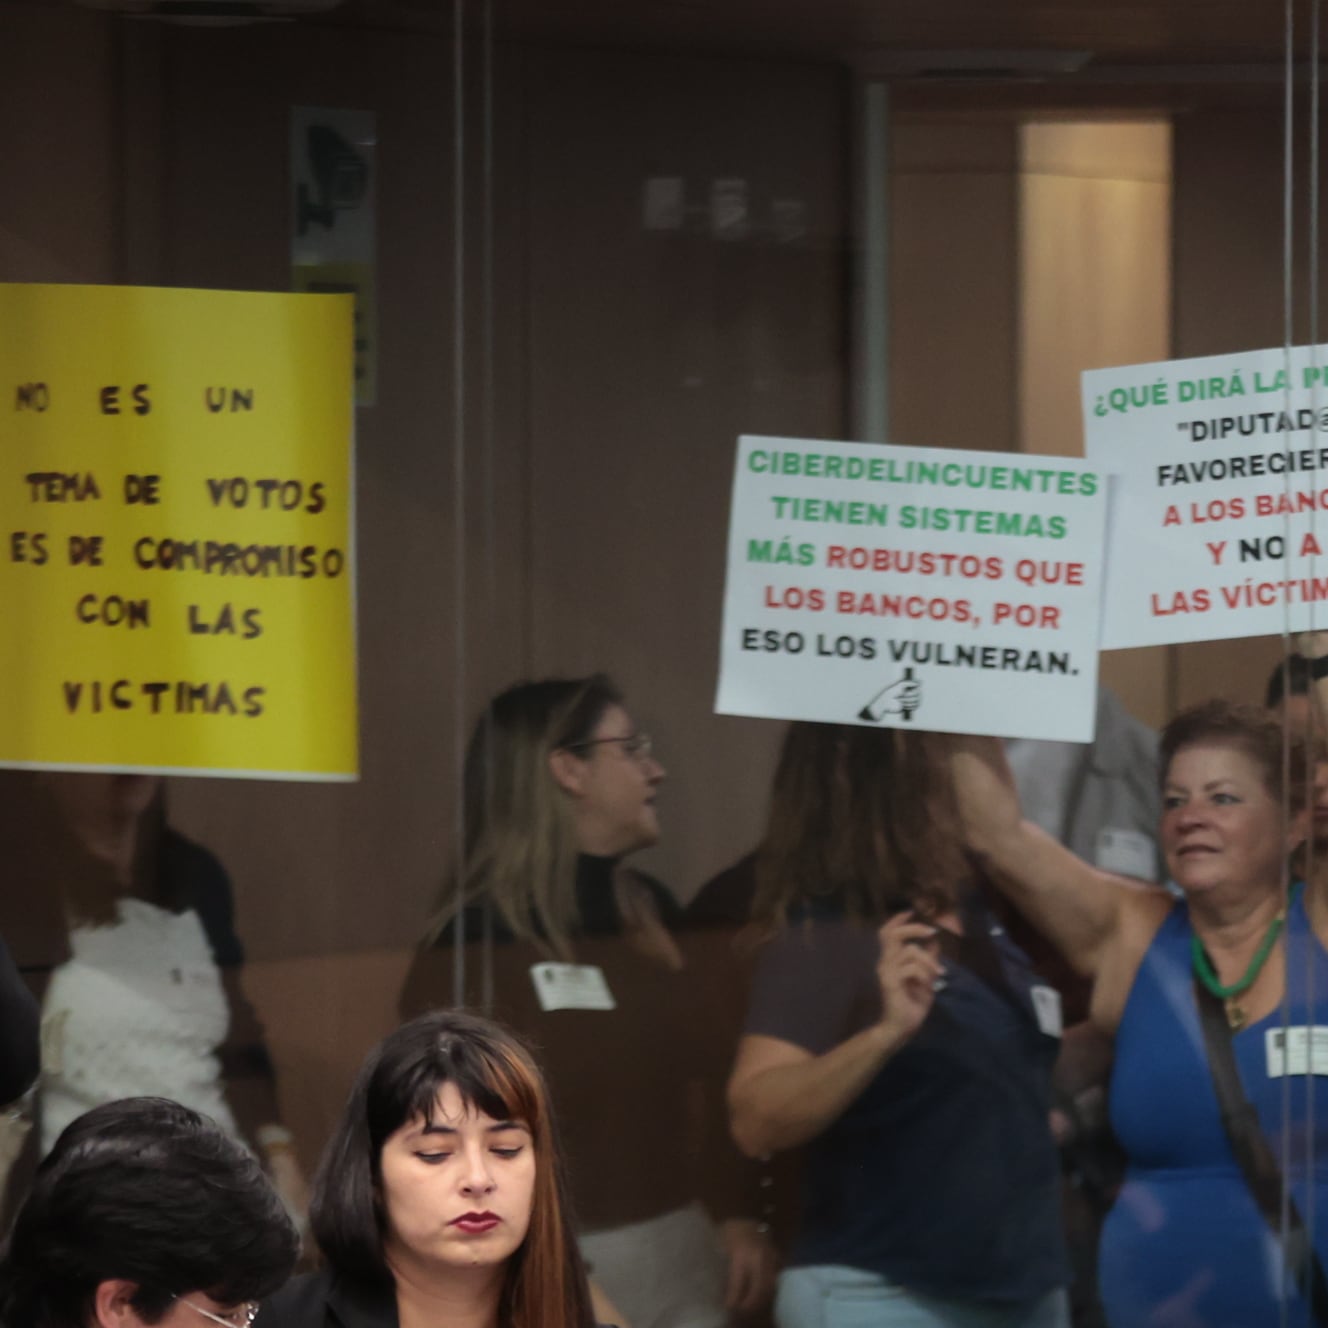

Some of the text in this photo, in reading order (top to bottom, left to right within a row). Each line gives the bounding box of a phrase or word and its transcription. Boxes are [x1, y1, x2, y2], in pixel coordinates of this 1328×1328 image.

[15, 382, 254, 415] NO ES UN
[1093, 378, 1168, 417] ¿QUÉ
[1177, 369, 1246, 403] DIRÁ
[1253, 369, 1291, 393] LA
[25, 472, 326, 514] TEMA DE VOTOS
[748, 450, 1098, 496] CIBERDELINCUENTES
[771, 496, 1067, 539] TIENEN SISTEMAS
[1162, 505, 1182, 527] A
[1190, 497, 1245, 525] LOS
[10, 532, 344, 579] ES DE COMPROMISO
[747, 535, 1085, 587] MÁS ROBUSTOS QUE
[1206, 532, 1323, 566] Y NO A
[77, 594, 263, 640] CON LAS
[764, 585, 1061, 629] LOS BANCOS, POR
[1150, 589, 1211, 617] LAS
[741, 628, 1080, 676] ESO LOS VULNERAN.
[63, 680, 266, 718] VICTIMAS
